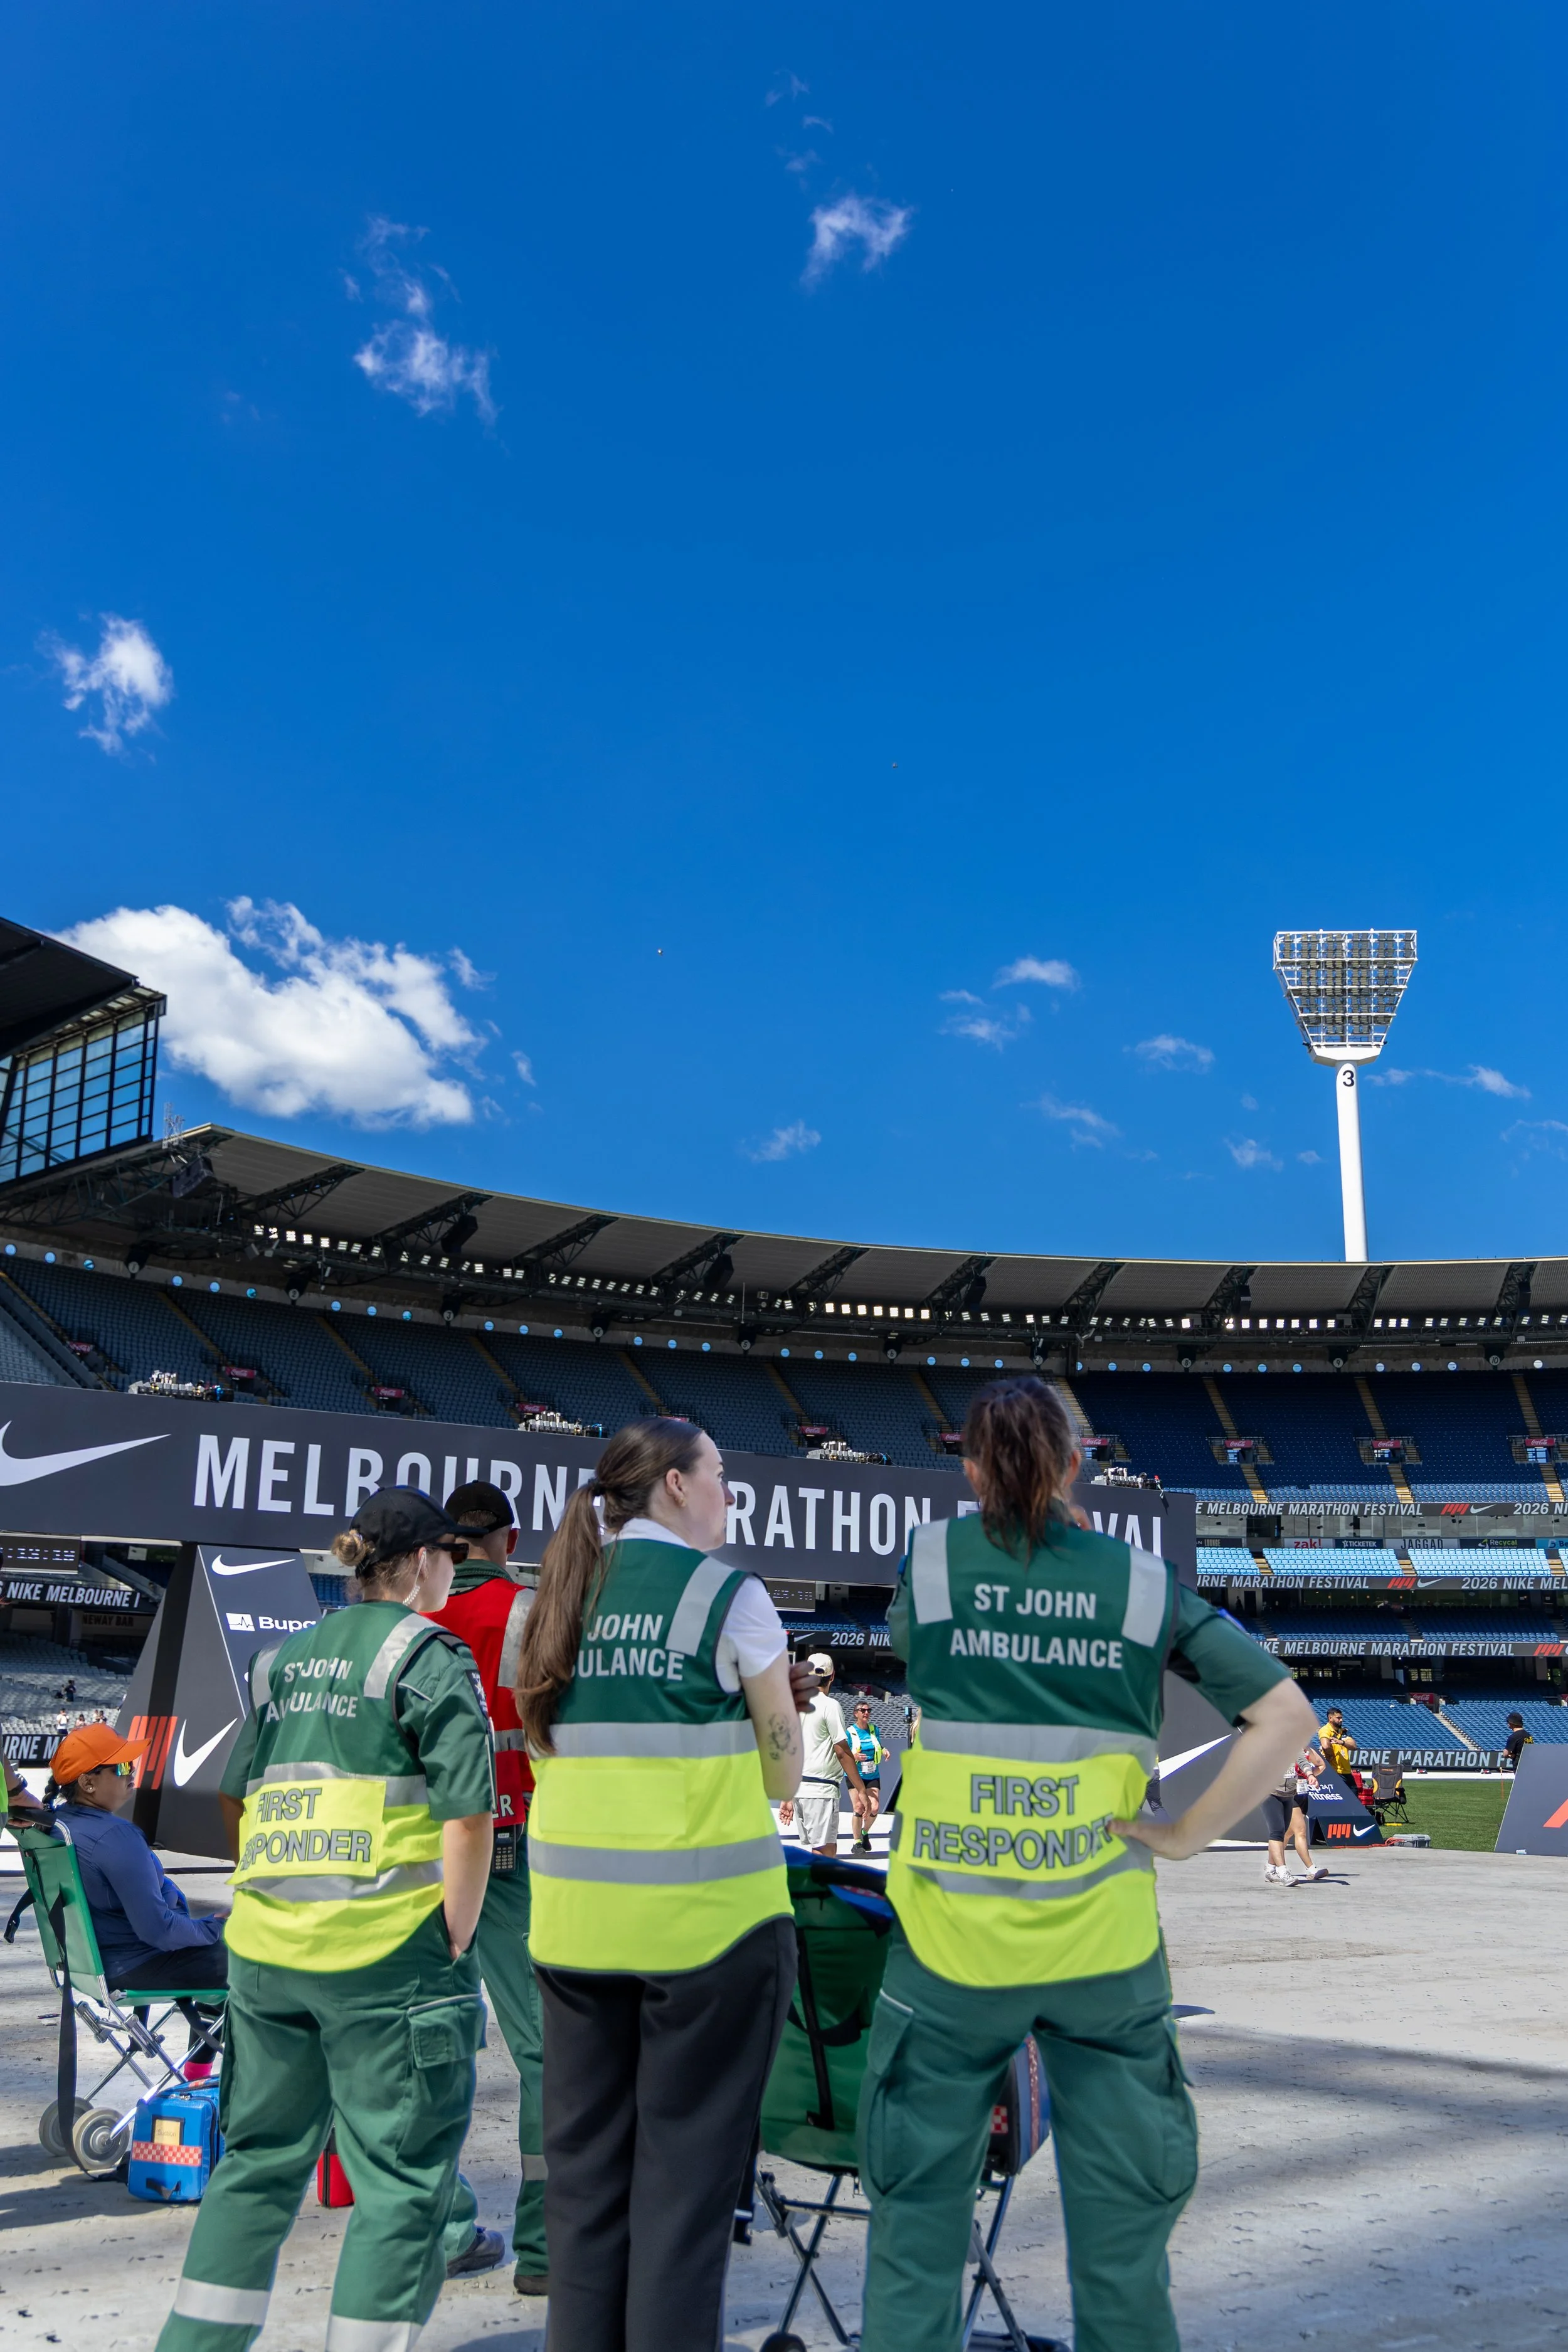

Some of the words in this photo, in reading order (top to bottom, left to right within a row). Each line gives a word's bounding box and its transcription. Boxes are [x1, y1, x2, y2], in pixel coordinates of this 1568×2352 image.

[1342, 1070, 1355, 1087] 3
[1207, 1503, 1285, 1515] MELBOURNE
[1288, 1503, 1360, 1516] MARATHON
[1364, 1503, 1423, 1516] FESTIVAL
[1513, 1503, 1549, 1515] 2026
[1294, 1539, 1322, 1549] zak!
[1401, 1539, 1444, 1550] JAGGAD
[1231, 1575, 1305, 1589] MARATHON
[1308, 1576, 1369, 1589] FESTIVAL
[1461, 1577, 1498, 1589] 2026
[1502, 1577, 1535, 1589] NIKE
[1540, 1577, 1568, 1589] MEL
[6, 1581, 44, 1601] NIKE
[45, 1584, 132, 1608] MELBOURNE
[973, 1583, 1010, 1613] ST
[1015, 1588, 1096, 1619] JOHN
[115, 1616, 134, 1627] BAR
[586, 1614, 664, 1642] JOHN
[830, 1632, 865, 1646] 2026
[869, 1633, 893, 1646] NIK
[950, 1628, 1123, 1669] AMBULANCE
[1284, 1641, 1366, 1655] MELBOURNE
[1370, 1642, 1446, 1656] MARATHON
[1451, 1643, 1515, 1656] FESTIVAL
[571, 1647, 685, 1681] ULANCE
[1397, 1751, 1491, 1767] MARATHON
[970, 1773, 1080, 1818] FIRST
[1308, 1791, 1343, 1801] fitness
